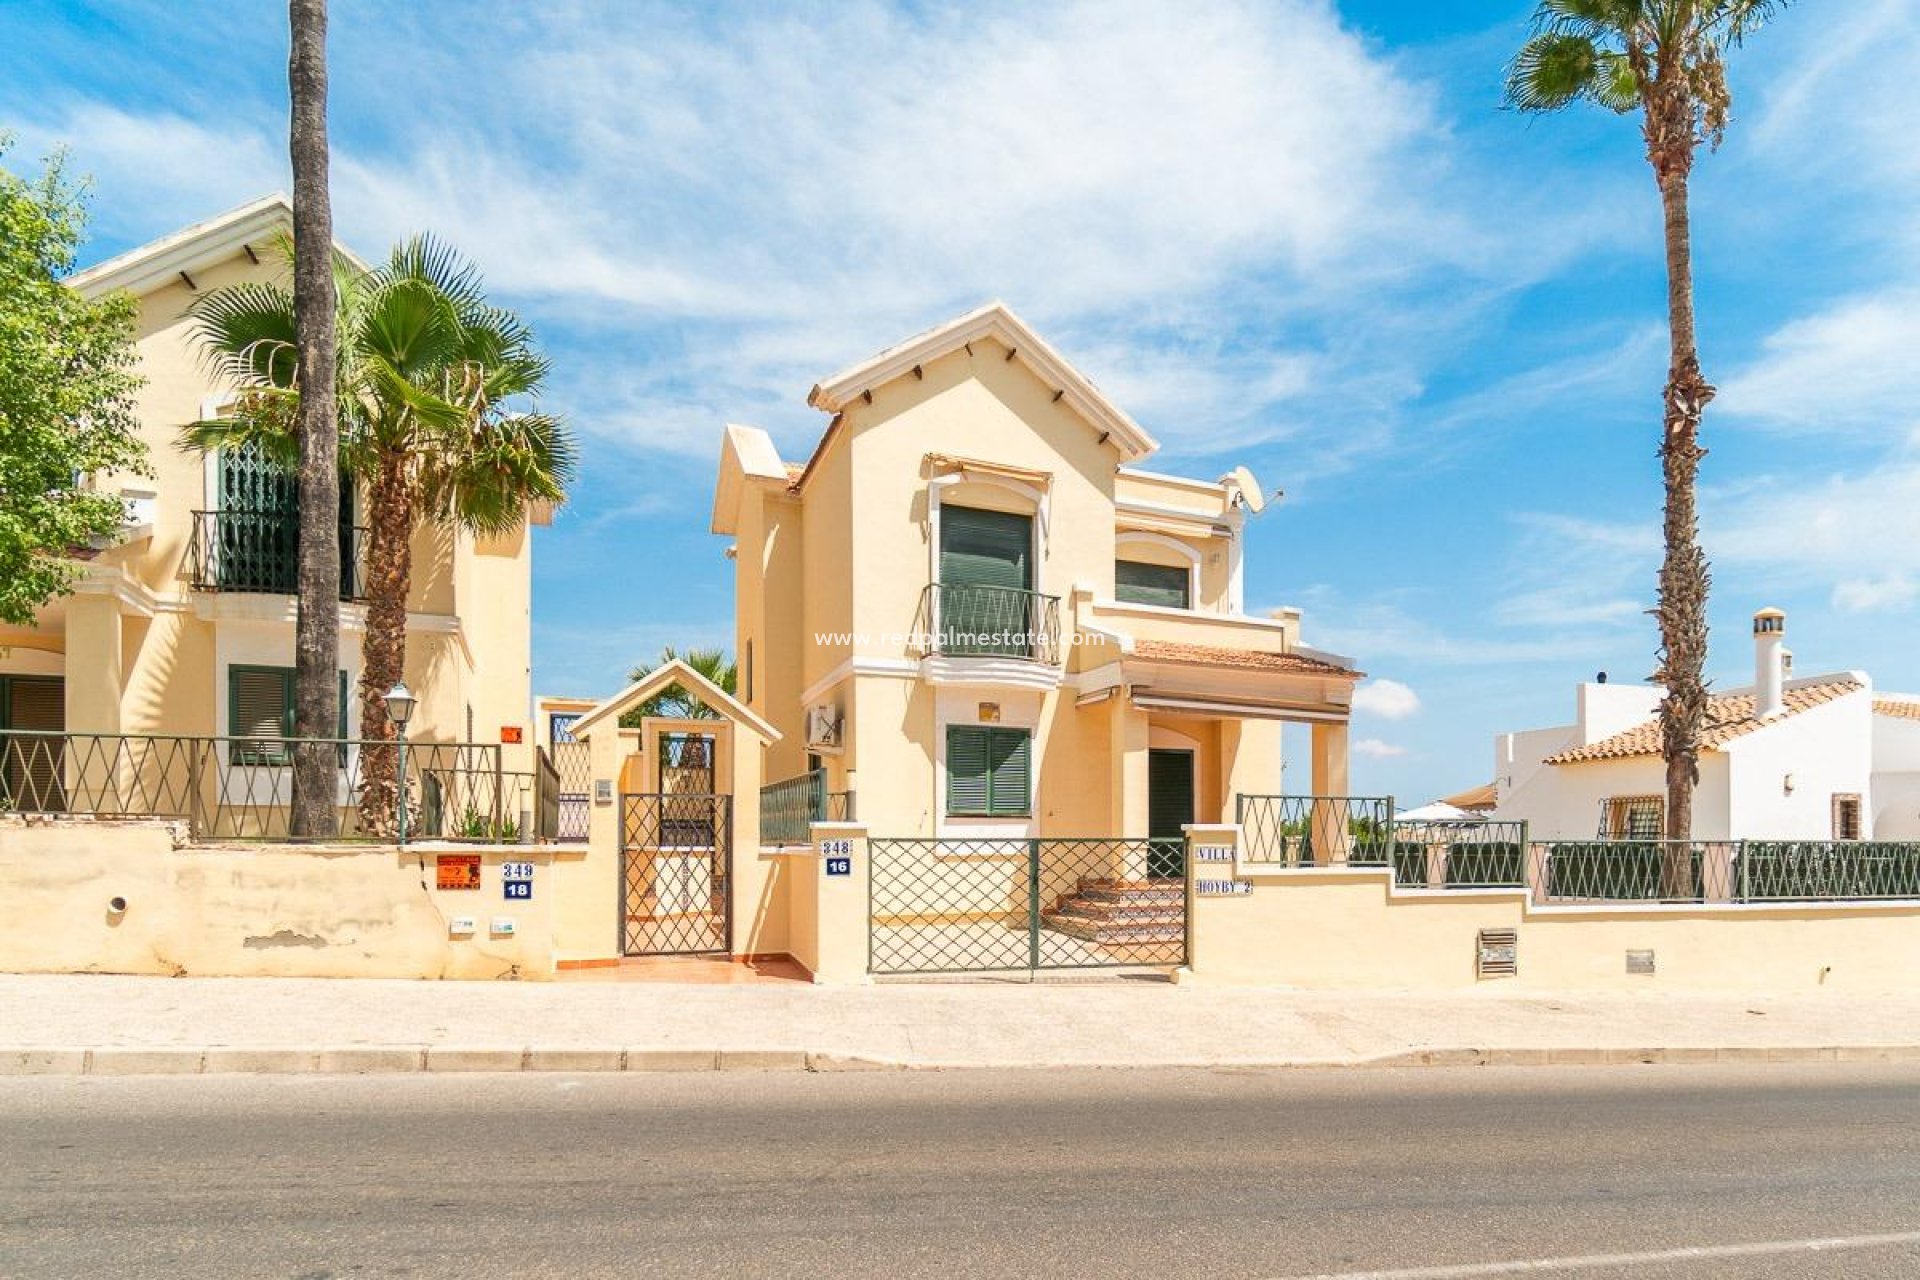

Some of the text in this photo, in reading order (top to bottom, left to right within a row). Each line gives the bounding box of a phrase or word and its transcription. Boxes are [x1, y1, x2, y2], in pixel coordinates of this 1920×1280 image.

[823, 841, 849, 855] 348
[503, 863, 533, 877] 349
[829, 861, 848, 873] 16
[508, 884, 527, 897] 18
